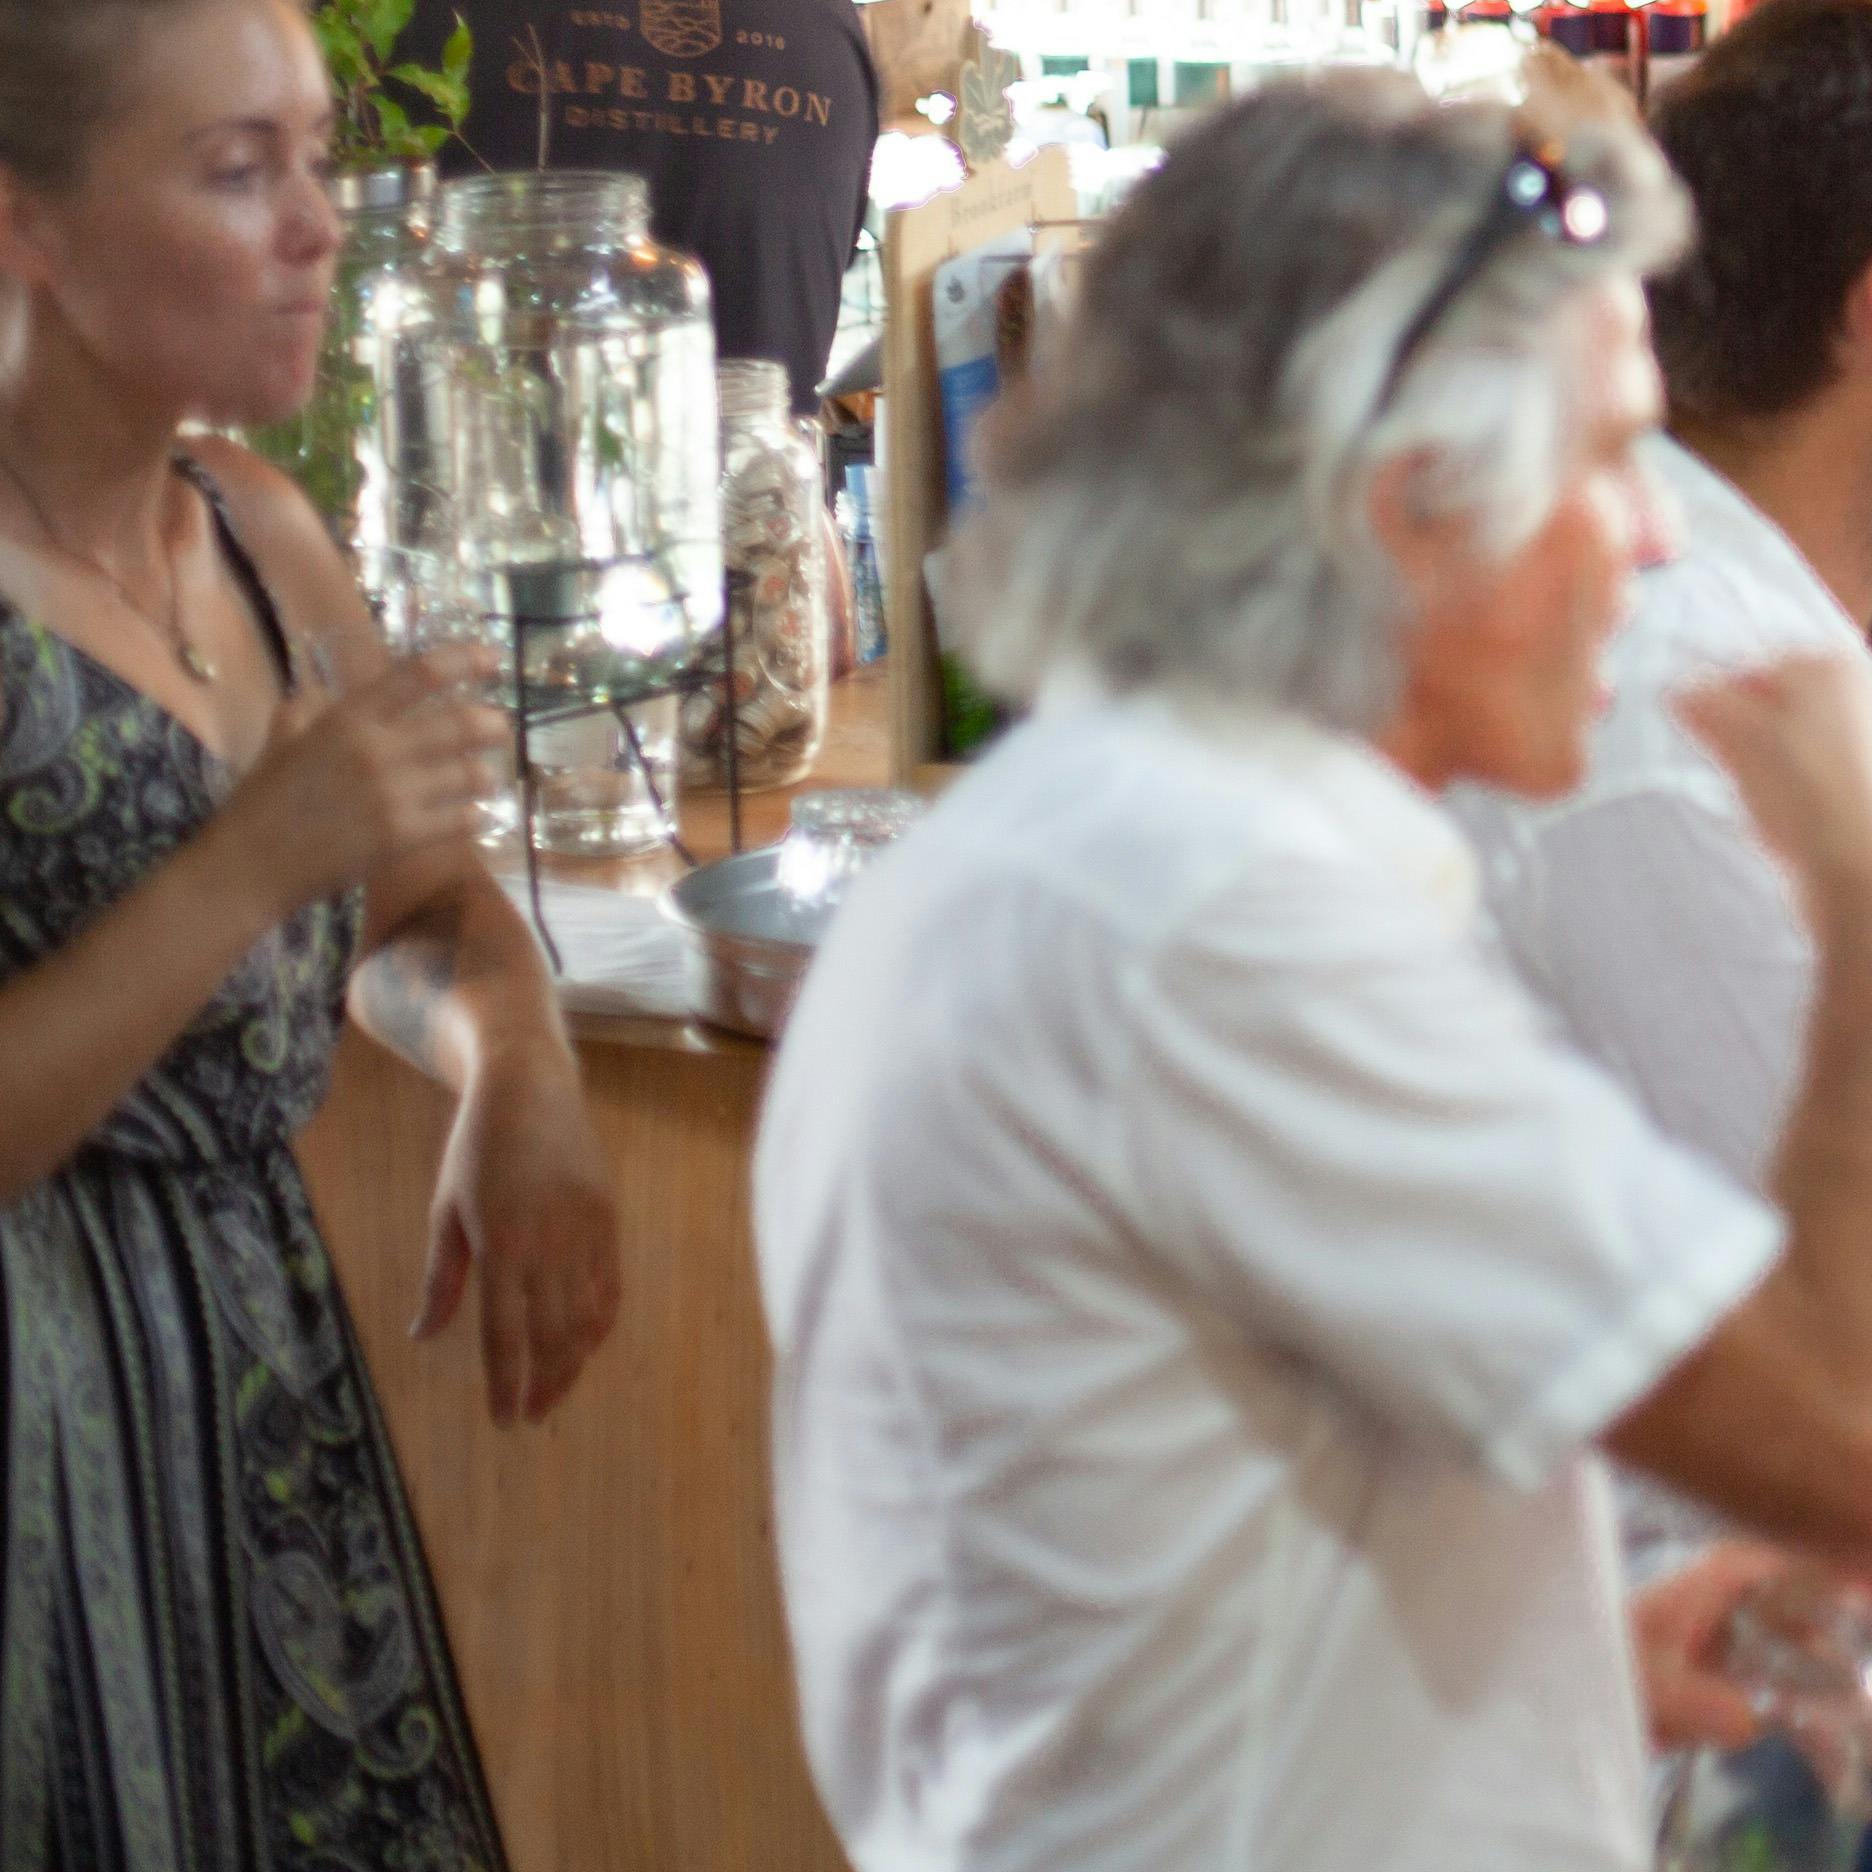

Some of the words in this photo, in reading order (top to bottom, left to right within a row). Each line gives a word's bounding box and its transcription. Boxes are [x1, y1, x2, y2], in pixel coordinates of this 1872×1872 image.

[505, 59, 649, 100] CAPE
[667, 71, 833, 128] BYRON
[565, 104, 781, 145] DISTILLERY
